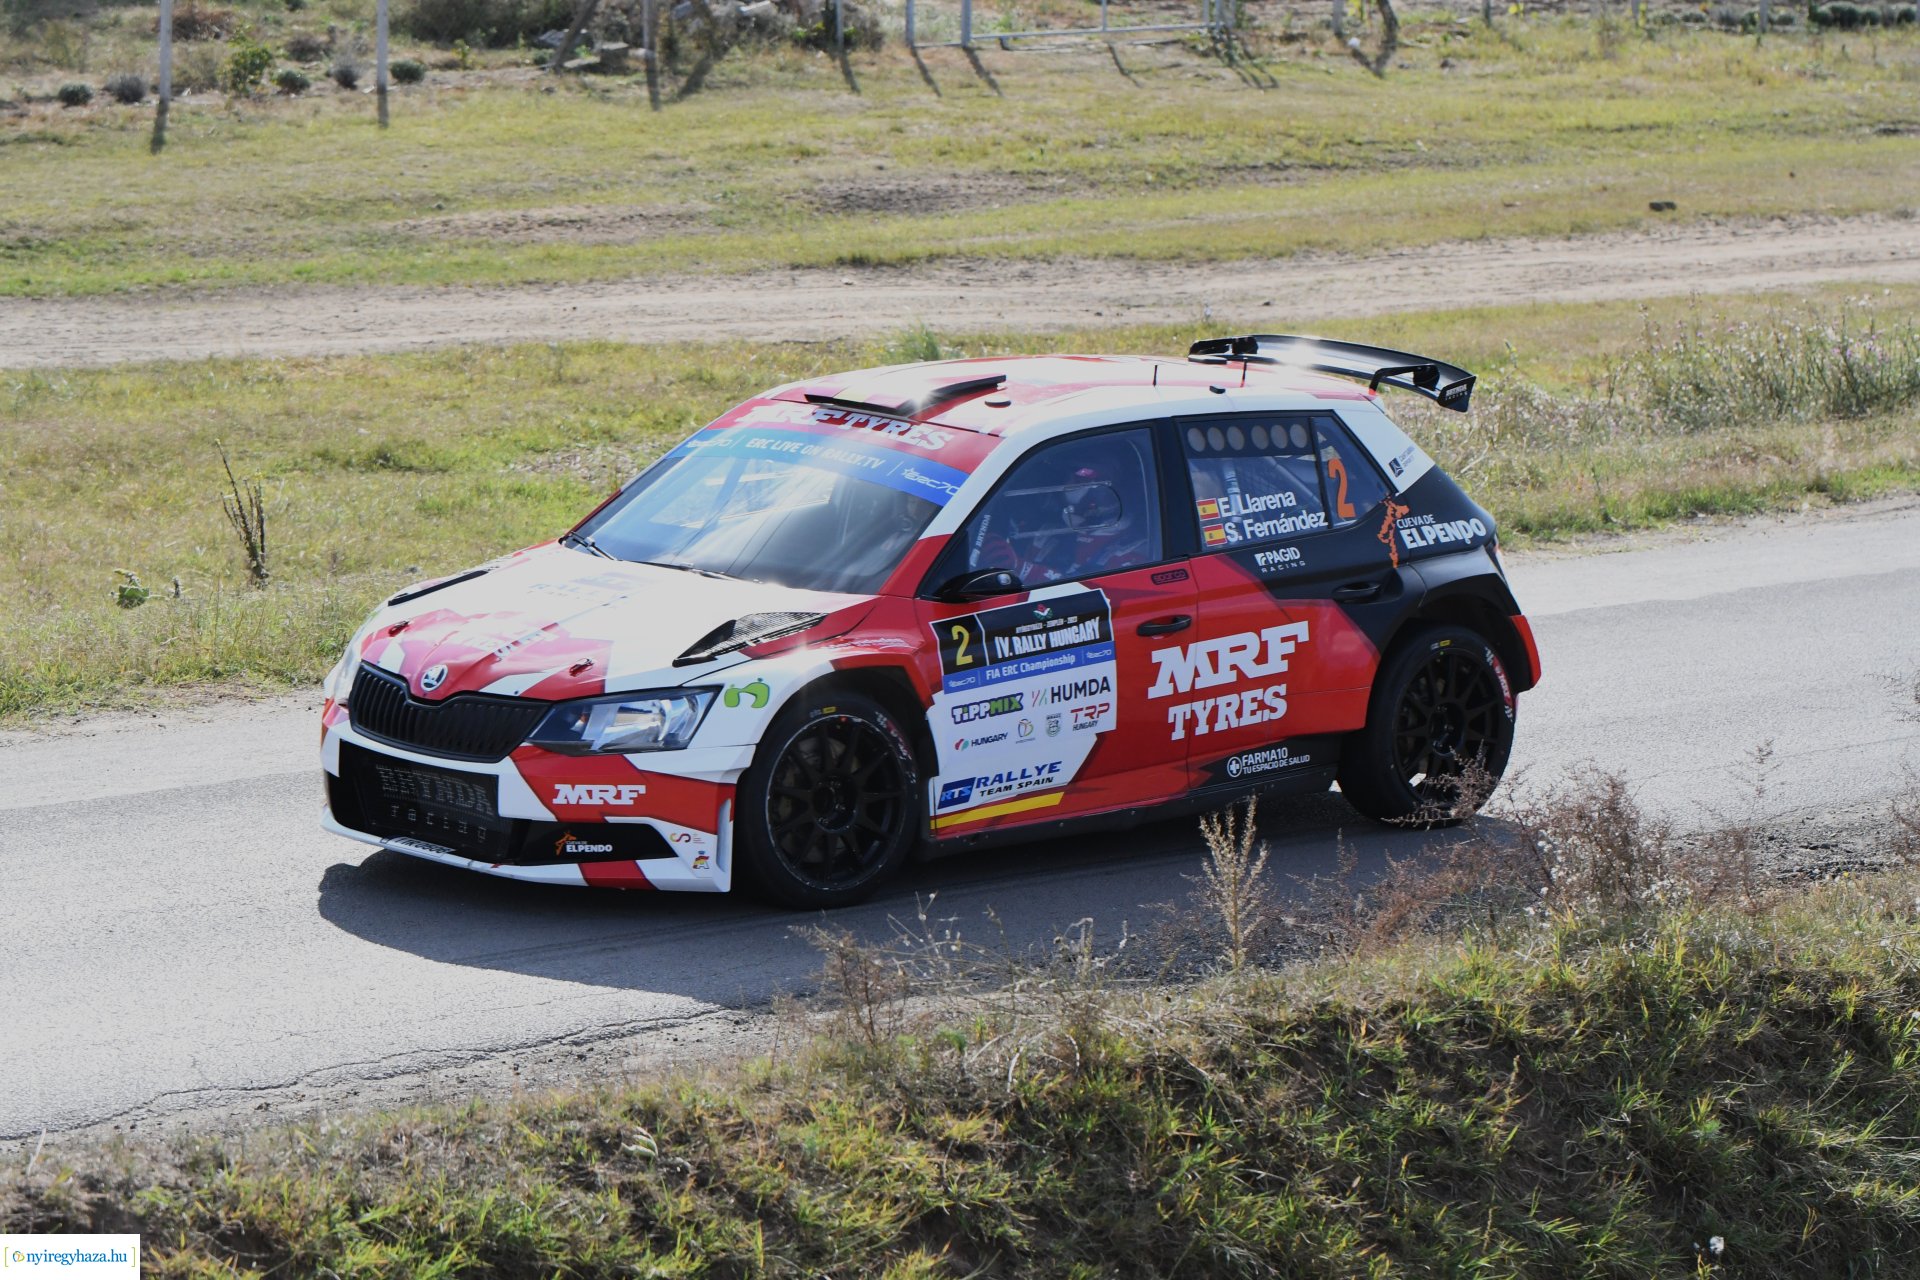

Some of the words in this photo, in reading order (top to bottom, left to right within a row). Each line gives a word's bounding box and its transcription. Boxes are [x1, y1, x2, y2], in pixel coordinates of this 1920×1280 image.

[841, 412, 955, 450] TYRES
[745, 438, 770, 450] ERC
[770, 438, 803, 453] LIVE
[801, 445, 821, 457] ON
[819, 446, 887, 470] RALLY.TV
[1327, 458, 1356, 519] 2
[1238, 491, 1298, 515] Llarena
[1225, 521, 1243, 543] S.
[1242, 509, 1329, 541] Fernández
[1395, 515, 1424, 529] CUEVA
[1262, 560, 1307, 573] RACING
[1266, 547, 1301, 565] PAGID
[951, 624, 974, 666] 2
[994, 635, 1013, 659] IV.
[1013, 631, 1047, 656] RALLY
[1050, 616, 1101, 649] HUNGARY
[986, 669, 1001, 681] FIA
[1002, 666, 1018, 677] ERC
[1020, 652, 1076, 673] Championship
[1147, 620, 1310, 700] MRF
[1050, 676, 1111, 704] HUMDA
[1070, 702, 1110, 724] TRP
[1167, 683, 1288, 741] TYRES
[1072, 719, 1099, 732] HUNGARY
[971, 731, 1009, 748] HUNGARY
[1242, 747, 1288, 767] FARMA10
[1242, 765, 1252, 775] TU
[1252, 761, 1279, 773] ESPACIO
[1279, 758, 1289, 768] DE
[1288, 754, 1311, 766] SALUD
[975, 760, 1063, 789] RALLYE
[552, 783, 647, 805] MRF
[940, 785, 973, 802] RTS
[980, 783, 1013, 798] TEAM
[1016, 776, 1055, 791] SPAIN
